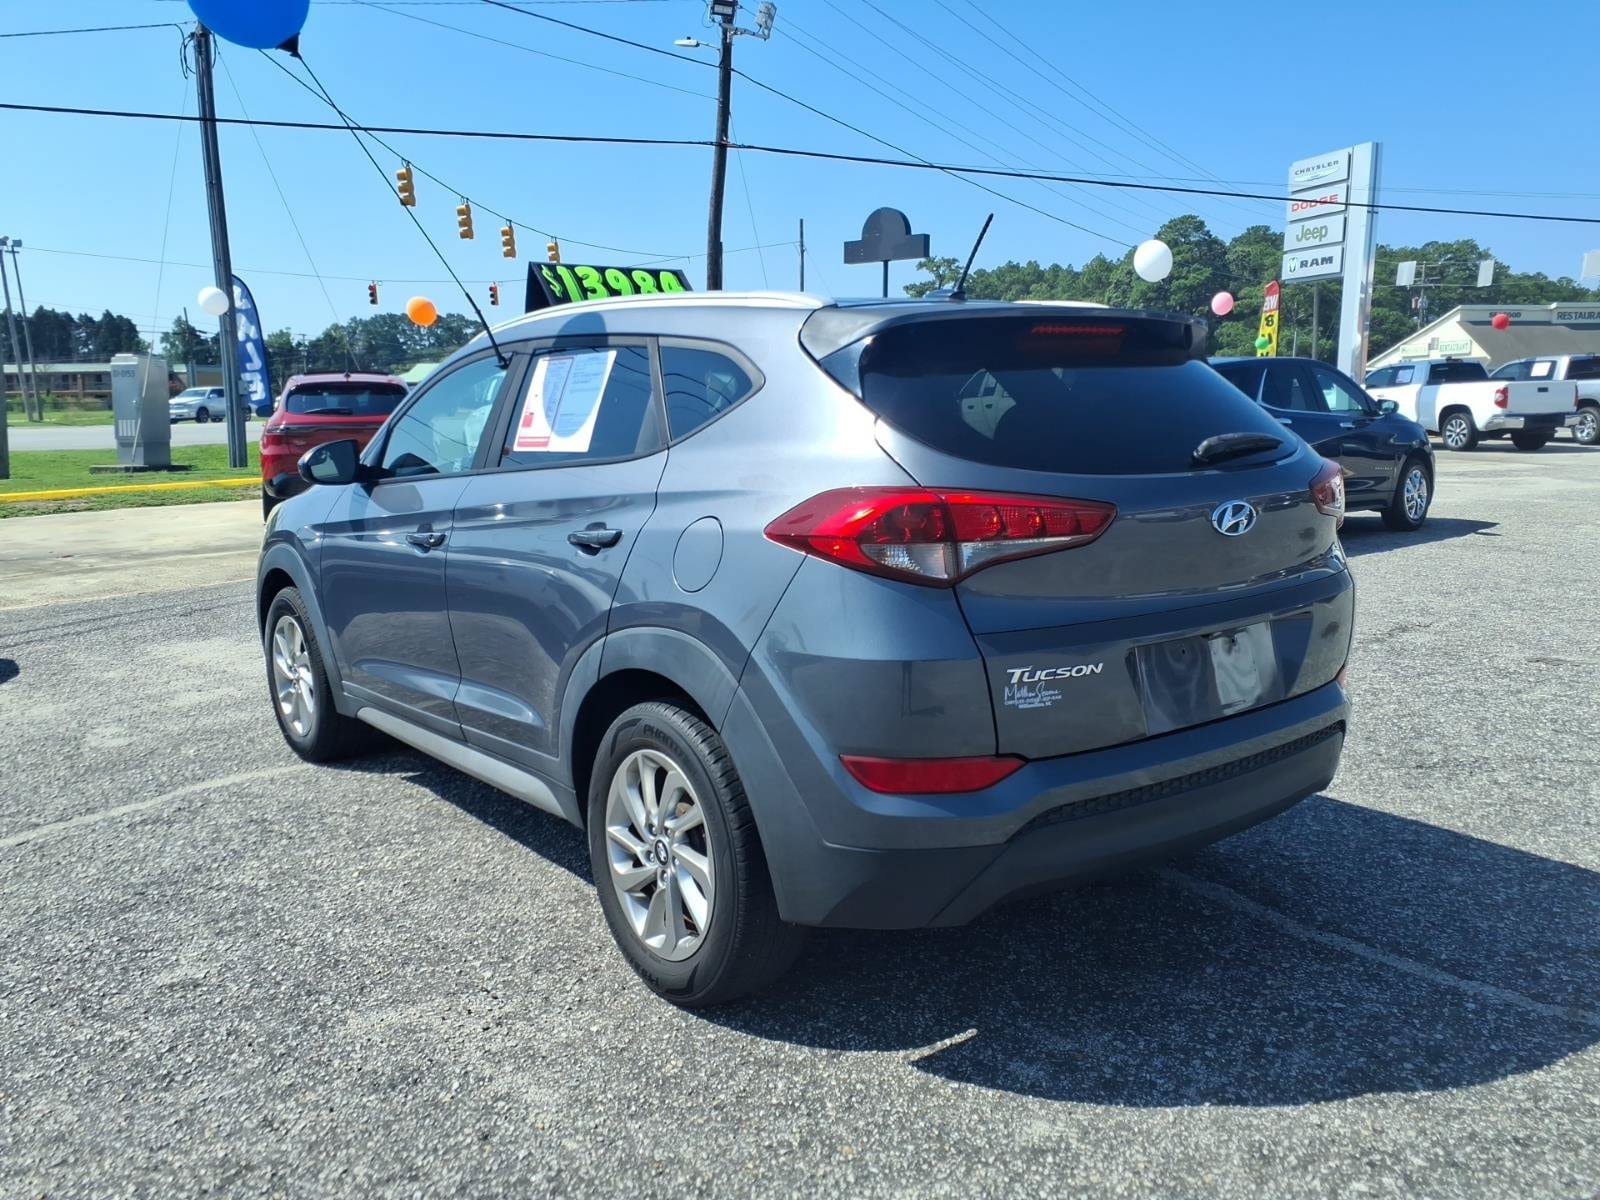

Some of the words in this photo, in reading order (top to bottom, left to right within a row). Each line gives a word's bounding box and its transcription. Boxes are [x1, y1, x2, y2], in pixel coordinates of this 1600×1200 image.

[1295, 159, 1340, 176] CHRYSLER
[1291, 194, 1338, 213] DODGE
[1296, 224, 1328, 243] Jeep
[1299, 256, 1334, 269] RAM
[1006, 662, 1104, 684] TUCSON
